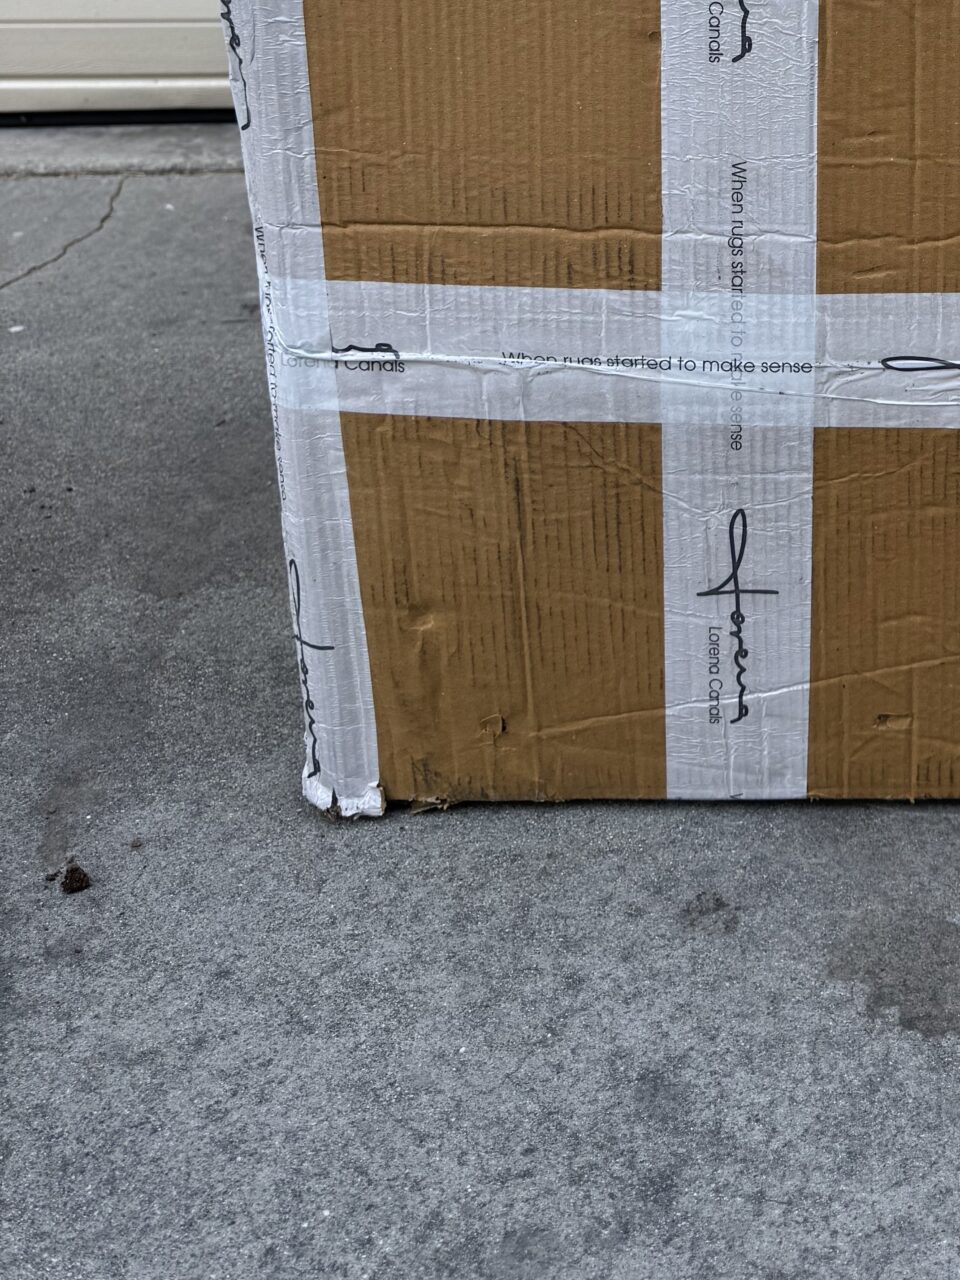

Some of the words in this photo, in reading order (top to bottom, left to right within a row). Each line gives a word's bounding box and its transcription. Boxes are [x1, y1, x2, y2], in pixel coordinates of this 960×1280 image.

[708, 1, 724, 64] Canals
[731, 161, 747, 214] When
[727, 219, 744, 257] rugs
[730, 261, 747, 323] started
[730, 330, 747, 348] to
[344, 359, 406, 373] Canals
[606, 354, 672, 372] started
[677, 356, 697, 372] to
[702, 358, 756, 373] make
[761, 360, 813, 374] sense
[730, 406, 743, 451] sense
[708, 626, 723, 675] Lorena
[708, 678, 724, 725] Canals
